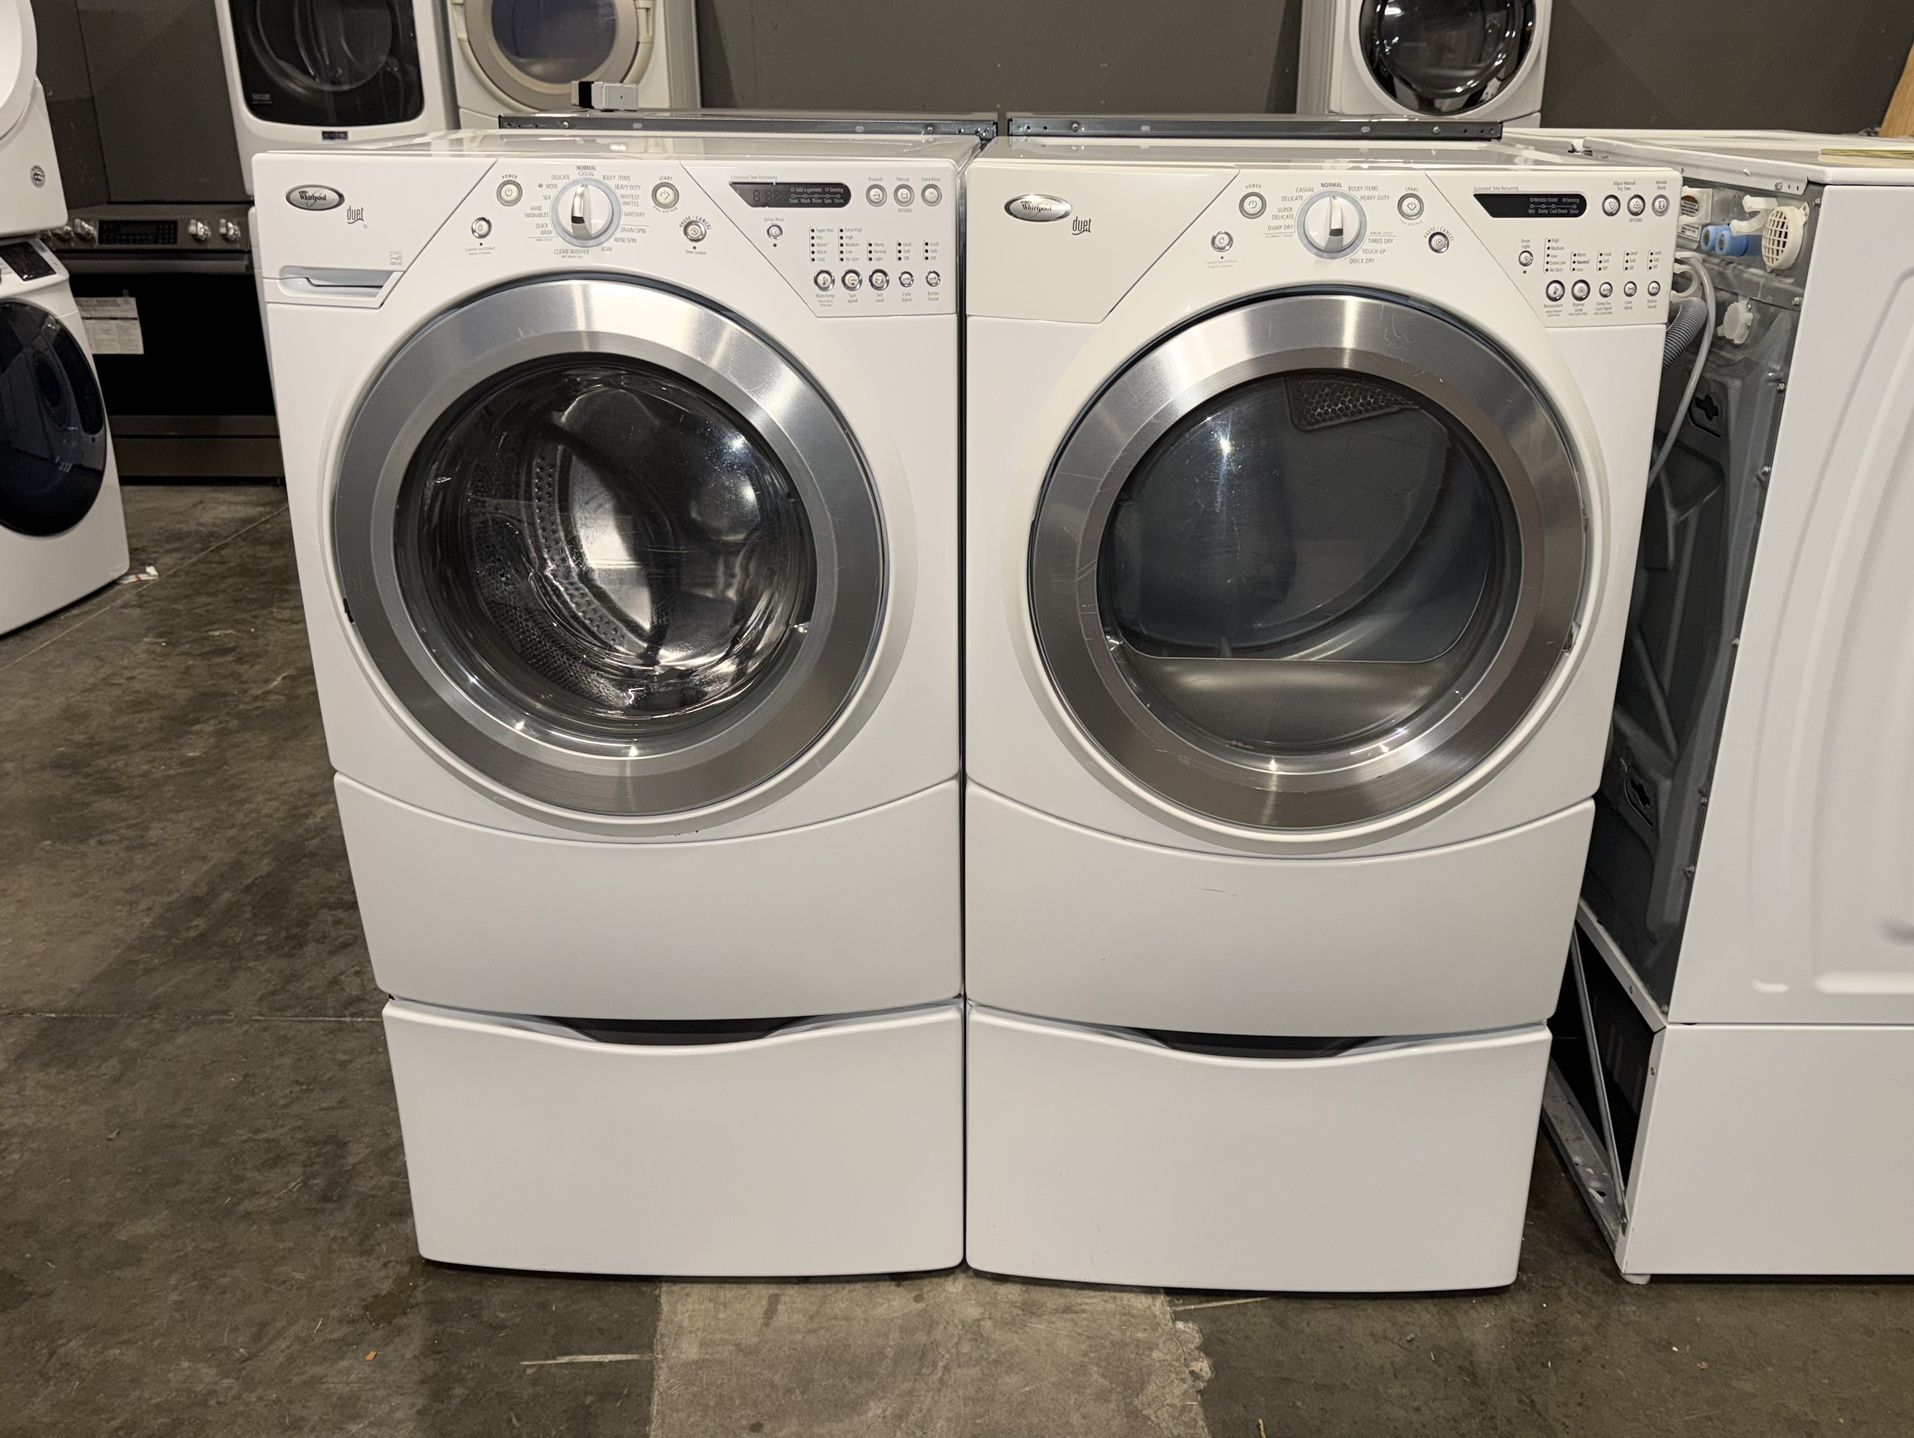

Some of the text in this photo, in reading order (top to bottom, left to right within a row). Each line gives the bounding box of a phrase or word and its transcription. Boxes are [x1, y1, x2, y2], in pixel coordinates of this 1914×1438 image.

[618, 174, 631, 182] ITEMS
[298, 190, 327, 203] Whirlpool
[1020, 200, 1052, 213] Whirlpool
[347, 206, 364, 224] duet
[1271, 213, 1294, 221] DELICATE
[535, 222, 549, 230] QUICK
[1072, 216, 1092, 235] duet
[1282, 223, 1294, 231] DRY
[620, 227, 647, 235] DRAIN/SPIN
[1382, 237, 1394, 245] DRY
